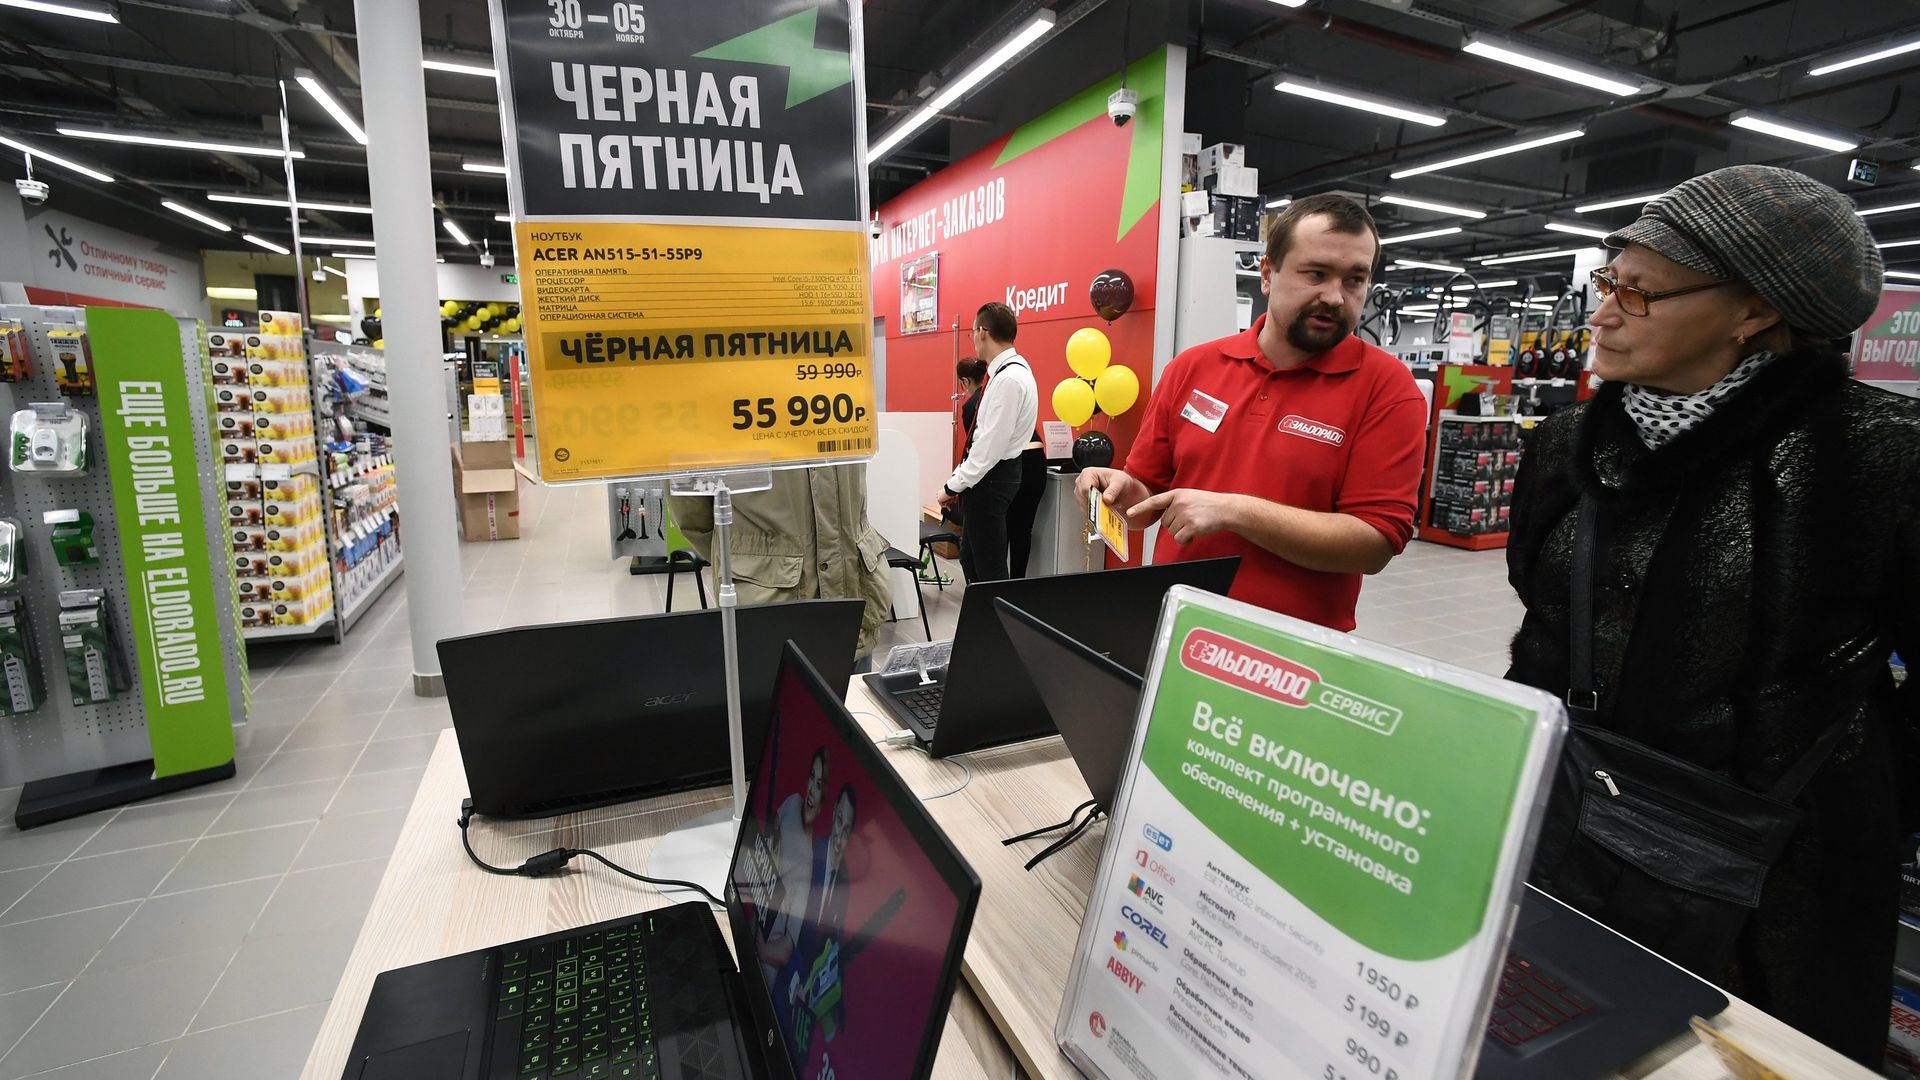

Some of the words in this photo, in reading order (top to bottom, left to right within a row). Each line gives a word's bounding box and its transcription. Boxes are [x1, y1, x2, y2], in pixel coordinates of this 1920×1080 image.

[547, 0, 582, 29] 30
[613, 2, 646, 34] 05
[549, 28, 584, 39] ОКТЯБРЯ
[615, 33, 645, 43] НОЯБРЯ
[551, 61, 761, 128] ЧЕРНАЯ
[559, 133, 804, 203] ПЯТНИЦА
[531, 232, 583, 241] НОУТБУК
[80, 240, 137, 270] Отличному
[138, 259, 168, 277] товару
[533, 248, 578, 261] ACER
[583, 248, 702, 261] AN515-51-55P9
[84, 263, 133, 284] отличный
[135, 274, 166, 290] сервис
[536, 277, 585, 285] ПРОЦЕССОР
[537, 286, 590, 294] ВИДЕОКАРТА
[538, 295, 576, 303] ЖЕСТКИЙ
[578, 295, 600, 303] ДИСК
[539, 304, 578, 312] МАТРИЦА
[1006, 282, 1068, 317] Кредит
[540, 313, 605, 321] ОПЕРАЦИОННАЯ
[1890, 310, 1920, 334] ЭТО
[560, 332, 694, 363] ЧЁРНАЯ
[704, 330, 853, 357] ПЯТНИЦА
[796, 364, 818, 380] 59
[117, 380, 167, 428] ЕЩЕ
[733, 398, 777, 430] 55
[753, 432, 775, 440] ЦЕНА
[784, 430, 815, 438] УЧЕТОМ
[839, 426, 869, 435] СКИДОК
[127, 435, 180, 526] БОЛЬШЕ
[141, 533, 184, 562] НА
[146, 567, 205, 705] ELDORADO.RU
[1319, 690, 1390, 726] СЕРВИС
[1192, 701, 1243, 746] Всё
[1248, 733, 1431, 836] включено:
[1187, 738, 1264, 786] комплект
[1268, 778, 1420, 864] программного
[1181, 762, 1285, 826] обеспечения
[1290, 818, 1300, 831] +
[1302, 826, 1412, 895] установка
[1149, 860, 1176, 886] Office
[1206, 861, 1250, 894] Антивирус
[1144, 886, 1164, 907] AVG
[1199, 890, 1236, 920] Microsoft
[1121, 905, 1169, 949] COREL
[1191, 917, 1223, 947] Утилита
[1107, 956, 1144, 993] ABBYY
[1183, 948, 1231, 990] Обработчик
[1232, 986, 1254, 1007] фото
[1175, 977, 1222, 1020] Обработчик
[1225, 1018, 1251, 1044] видео
[1169, 1004, 1227, 1059] Распознавание
[1345, 1038, 1380, 1074] 990
